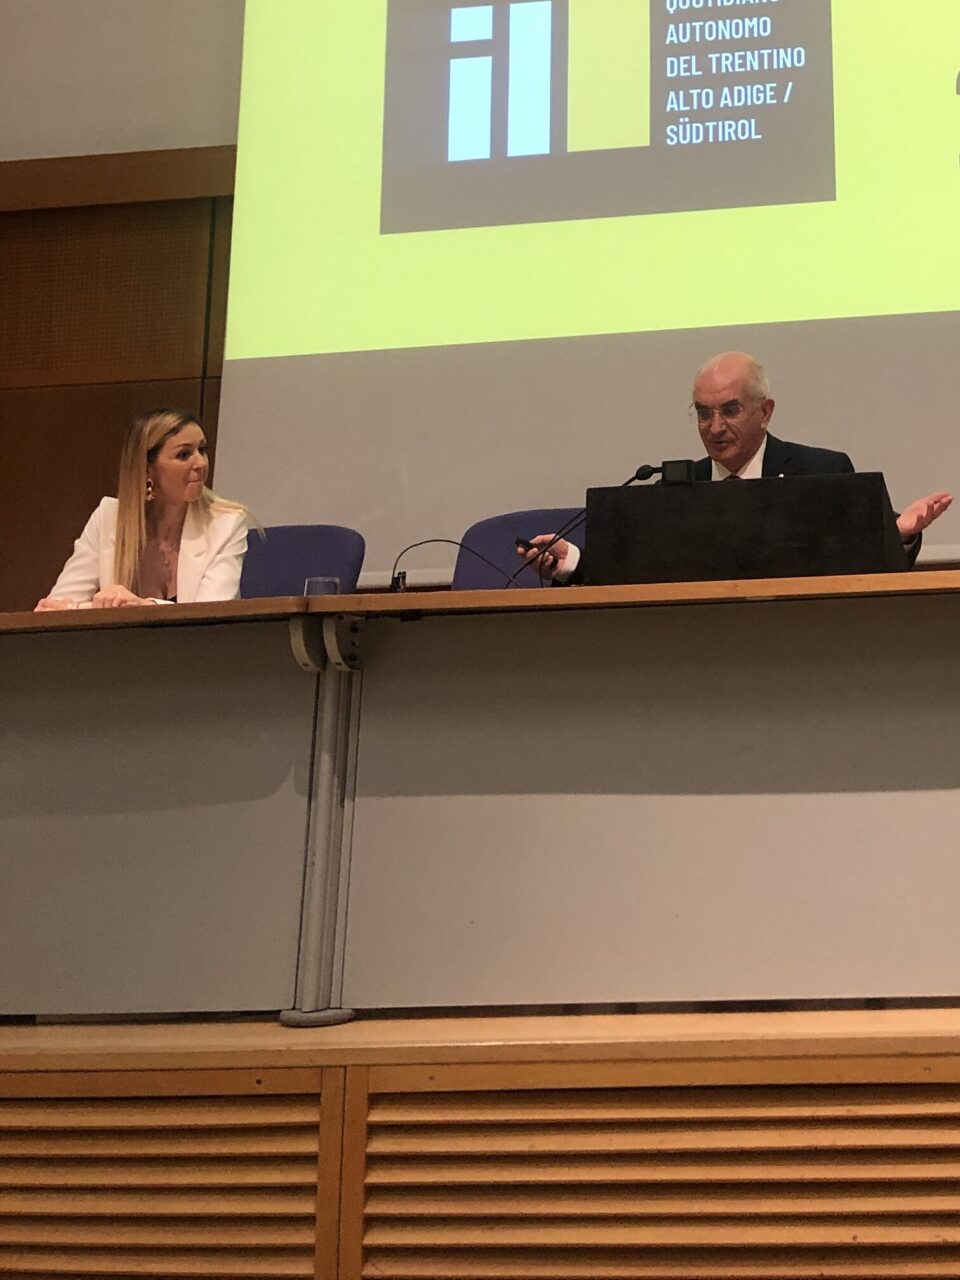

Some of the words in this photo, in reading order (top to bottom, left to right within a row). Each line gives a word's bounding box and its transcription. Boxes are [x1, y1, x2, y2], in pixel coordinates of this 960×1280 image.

[665, 16, 772, 45] AUTONOMO
[666, 55, 703, 78] DEL
[708, 47, 806, 74] TRENTINO
[666, 88, 714, 112] ALTO
[719, 83, 777, 108] ADIGE
[783, 81, 793, 103] /
[666, 117, 762, 146] SÜDTIROL
